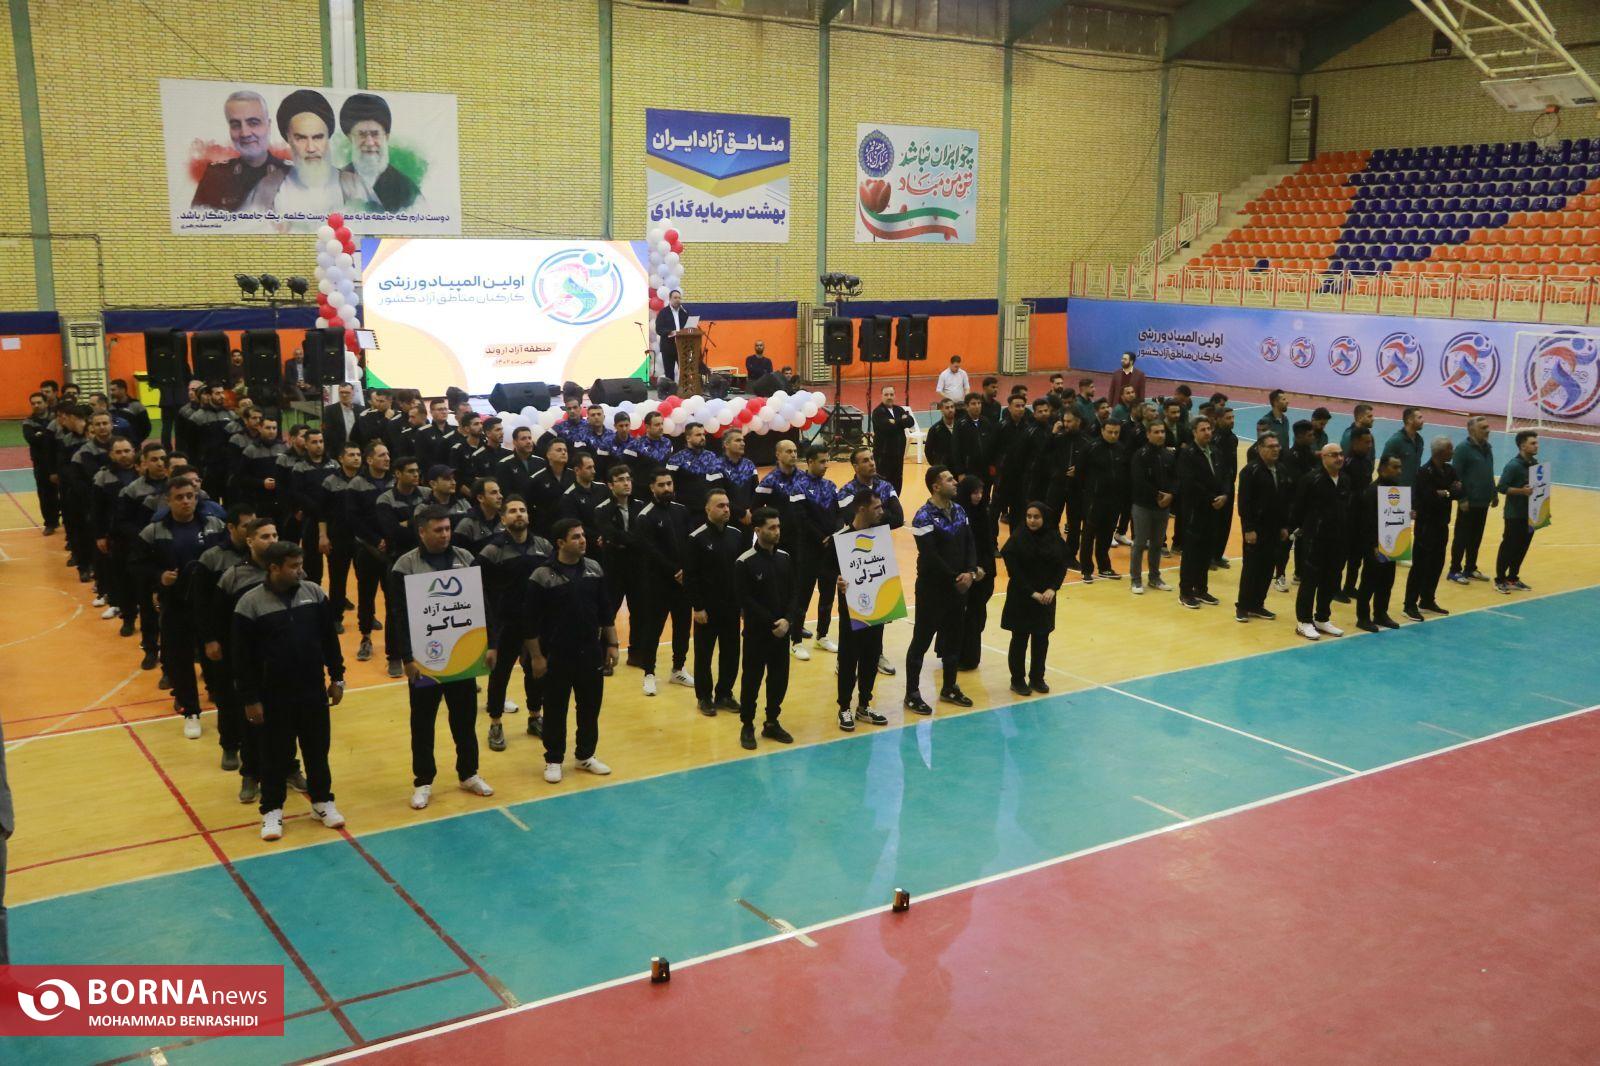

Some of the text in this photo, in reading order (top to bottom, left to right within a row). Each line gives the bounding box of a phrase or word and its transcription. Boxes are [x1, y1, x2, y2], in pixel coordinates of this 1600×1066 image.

[652, 128, 785, 155] مناطق آزاد ایران
[238, 211, 263, 220] جامعه
[264, 211, 280, 222] یک
[355, 214, 362, 223] به
[372, 213, 394, 221] جامعه
[409, 213, 424, 223] دارم
[425, 214, 450, 223] دوست
[746, 202, 786, 225] بهشت
[378, 275, 525, 292] اولین المپیاد ورزشی
[377, 292, 525, 305] کارکنان مناطق آزاد کشور
[1138, 328, 1224, 348] اولین المپیاد ورزشی
[485, 346, 508, 355] اروند
[508, 344, 523, 355] آزاد
[1137, 347, 1223, 363] کارکنان مناطق آزاد کشور
[849, 558, 862, 569] آزاد
[854, 564, 886, 585] انزلی
[423, 602, 471, 616] منطقه آزاد
[425, 616, 472, 636] ماکو
